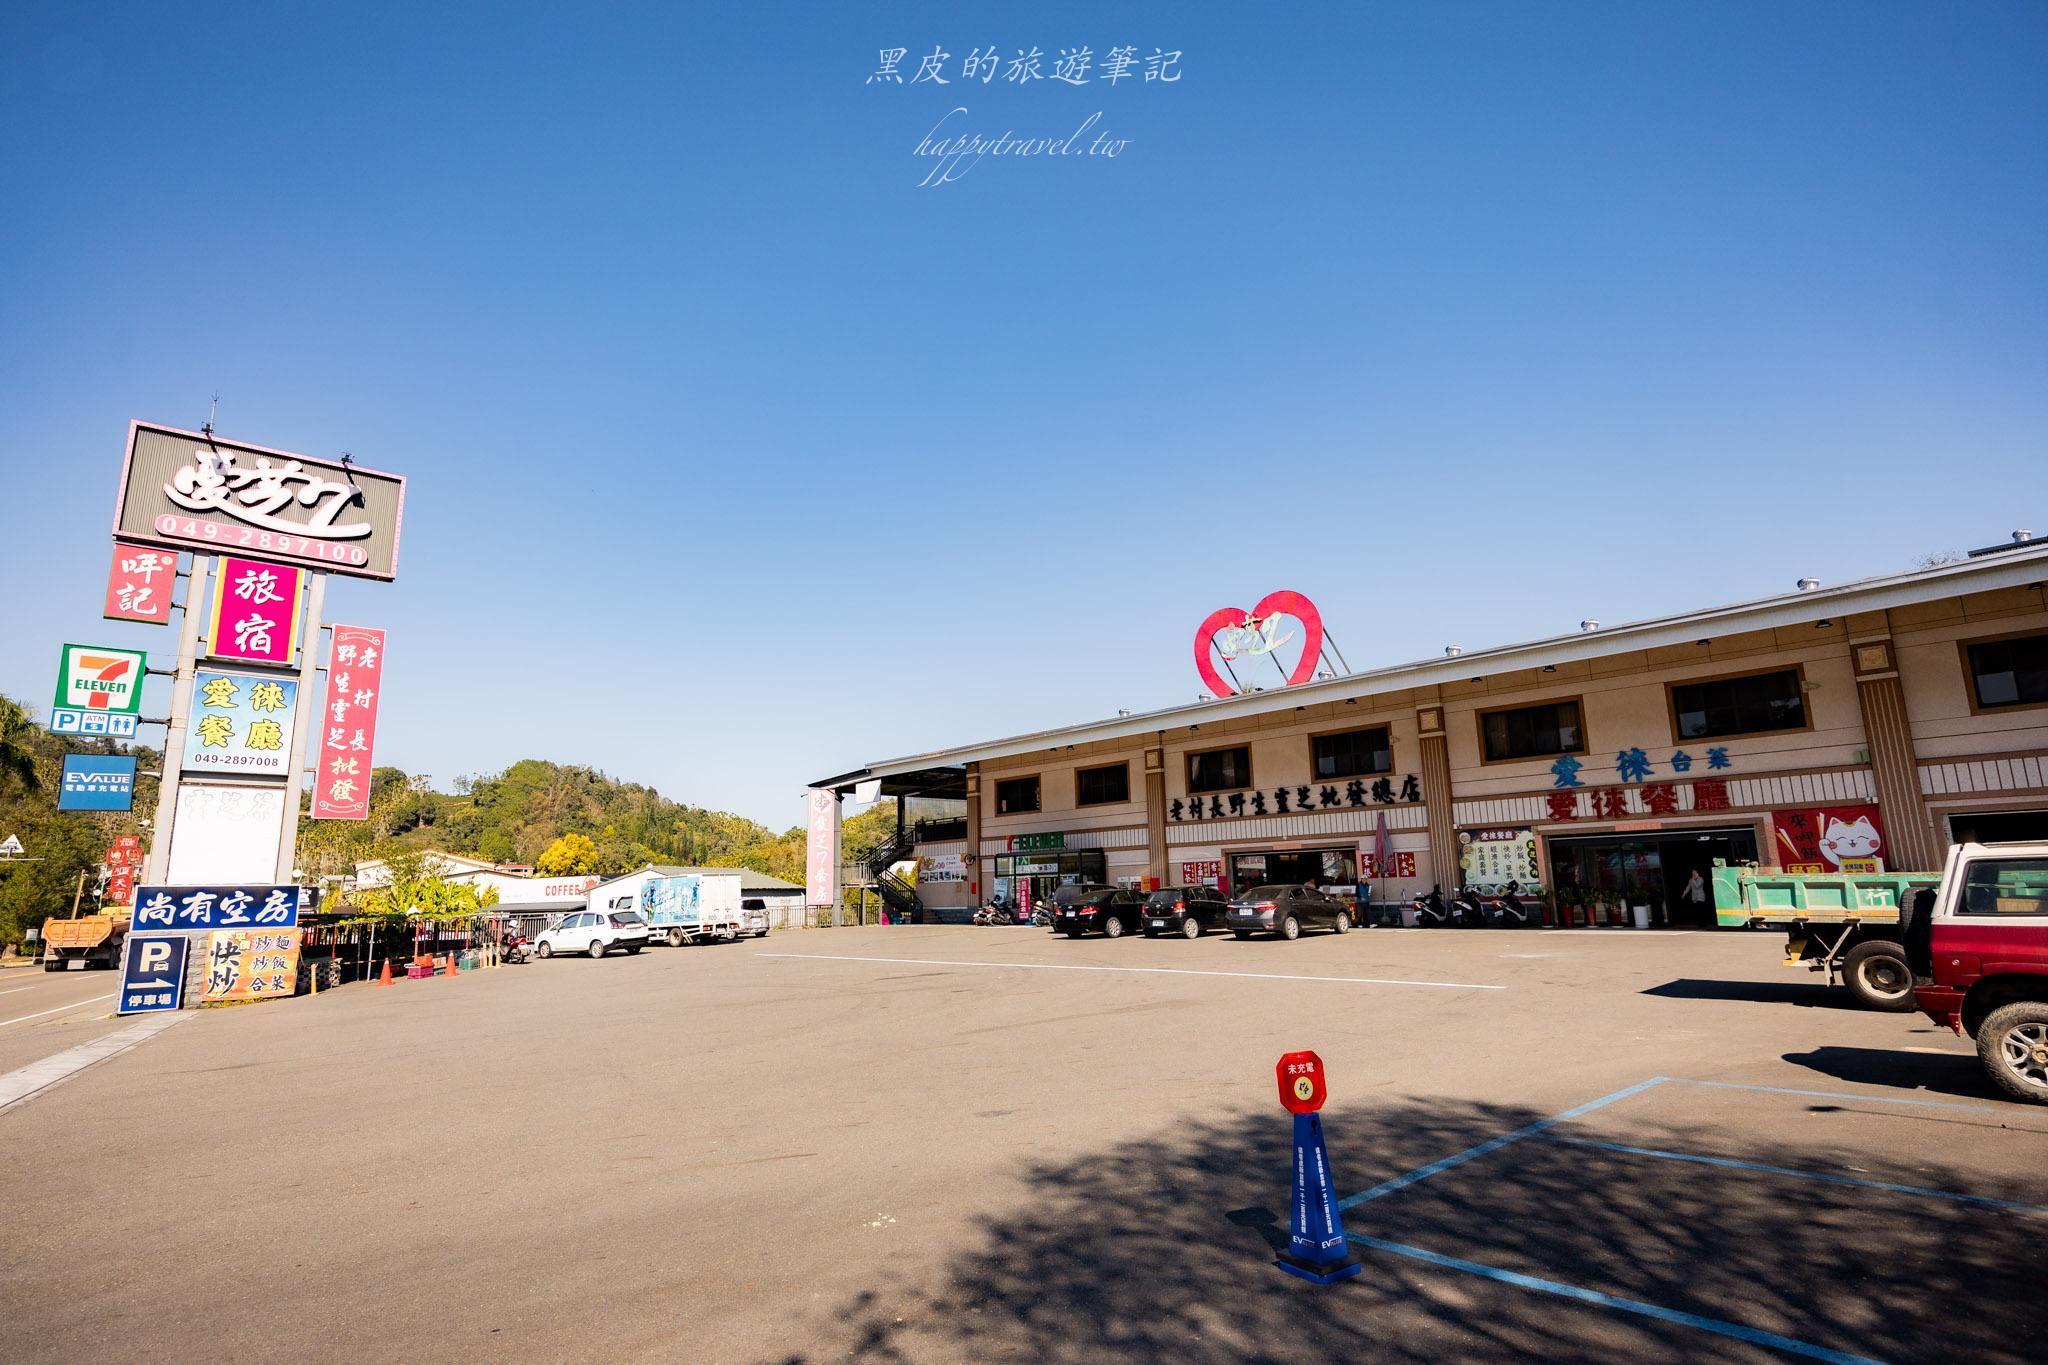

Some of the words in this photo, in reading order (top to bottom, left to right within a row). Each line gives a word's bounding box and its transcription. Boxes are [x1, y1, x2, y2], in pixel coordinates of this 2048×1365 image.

[161, 516, 365, 563] 049-2897100
[234, 569, 285, 655] 旅宿
[79, 655, 130, 708] 7
[348, 646, 379, 751] 老村長
[58, 714, 76, 728] P
[86, 715, 105, 723] ATM
[195, 714, 284, 751] 餐廳
[194, 753, 279, 767] 049-2897008
[1551, 746, 1732, 789] 愛徠台菜
[65, 784, 129, 793] 電動車充電站
[1547, 779, 1731, 822] 愛徠餐廳
[545, 885, 581, 897] COFFEE
[139, 889, 294, 925] 尚有空房
[254, 935, 290, 953] 炒麵
[139, 942, 172, 972] P
[207, 941, 241, 996] 快炒
[252, 956, 288, 971] 炒飯
[250, 975, 286, 992] 合菜
[128, 994, 171, 1006] 停車場
[1288, 1062, 1314, 1074] 未充電
